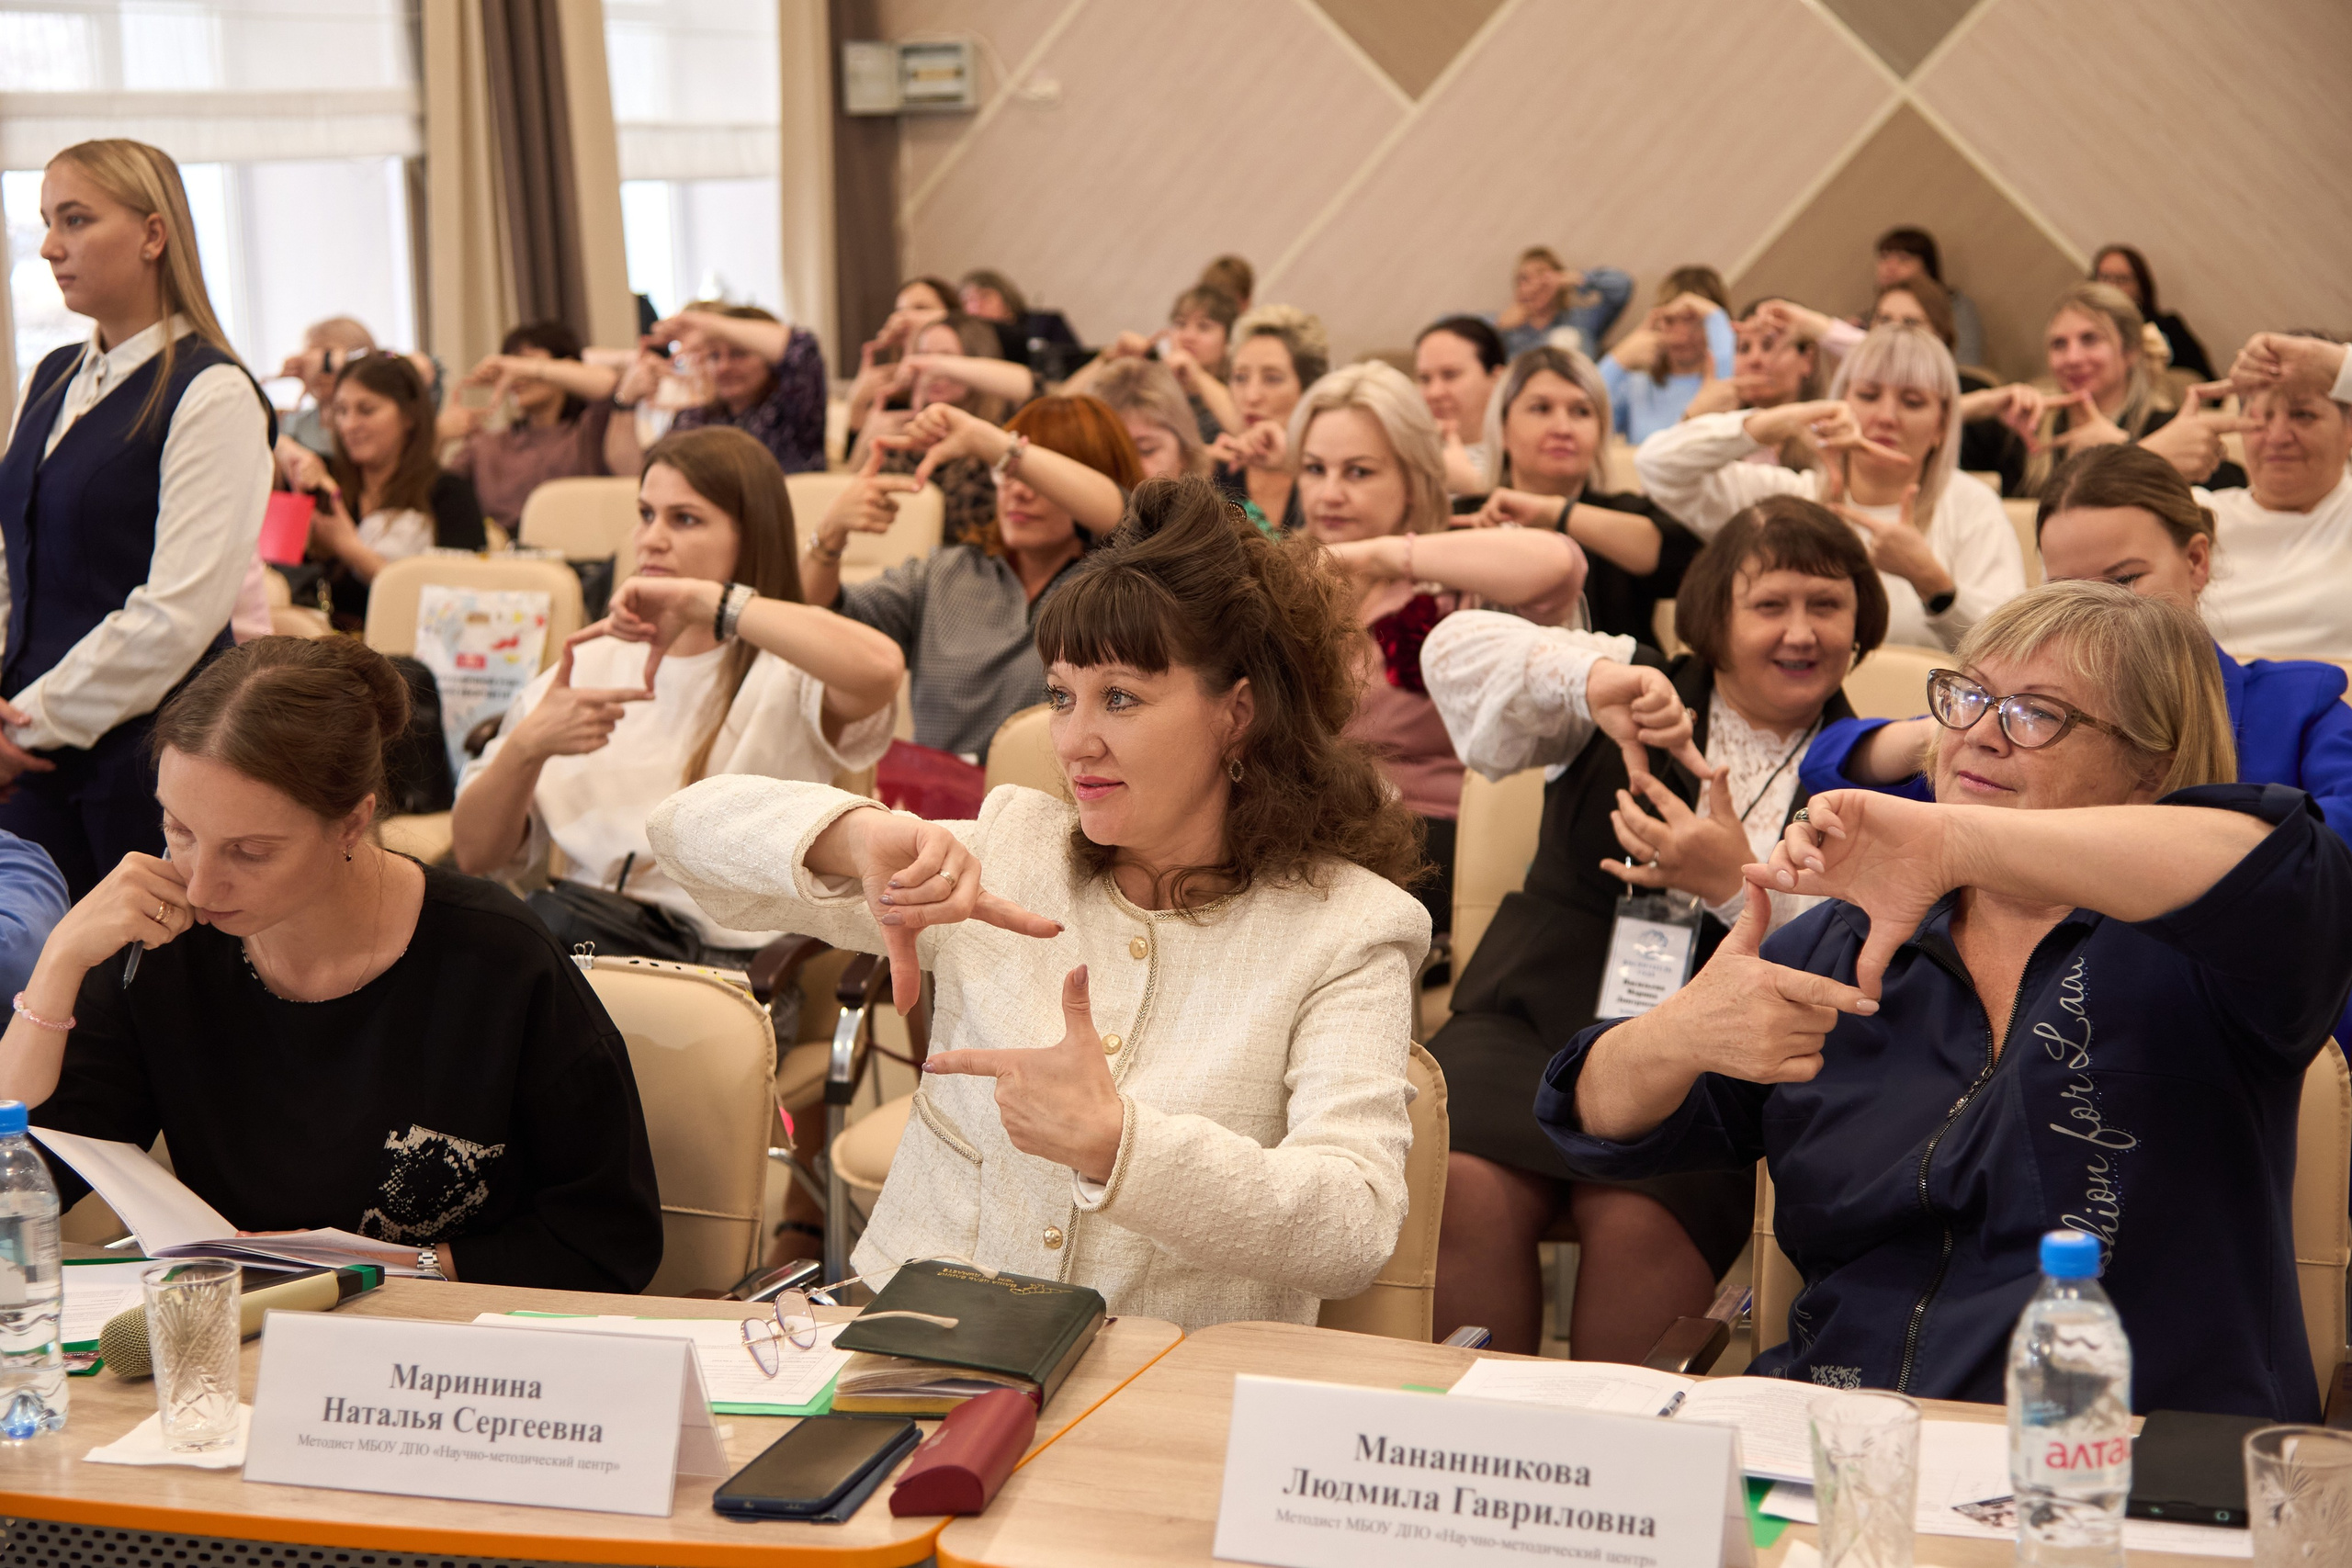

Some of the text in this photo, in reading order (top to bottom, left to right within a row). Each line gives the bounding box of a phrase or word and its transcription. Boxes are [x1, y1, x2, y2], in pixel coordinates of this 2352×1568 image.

[2049, 1072, 2138, 1150] for
[389, 1362, 543, 1400] Маринина
[322, 1396, 605, 1444] Наталья Сергеевна
[297, 1433, 622, 1473] Методист МБОУ ДПО «Научно-методический центр»
[1354, 1433, 1593, 1488] Мананникова
[1275, 1507, 1342, 1530] Методист
[1346, 1516, 1392, 1536] МБОУ
[1395, 1521, 1431, 1541] ДПО
[1283, 1468, 1657, 1539] Людмила Гавриловна
